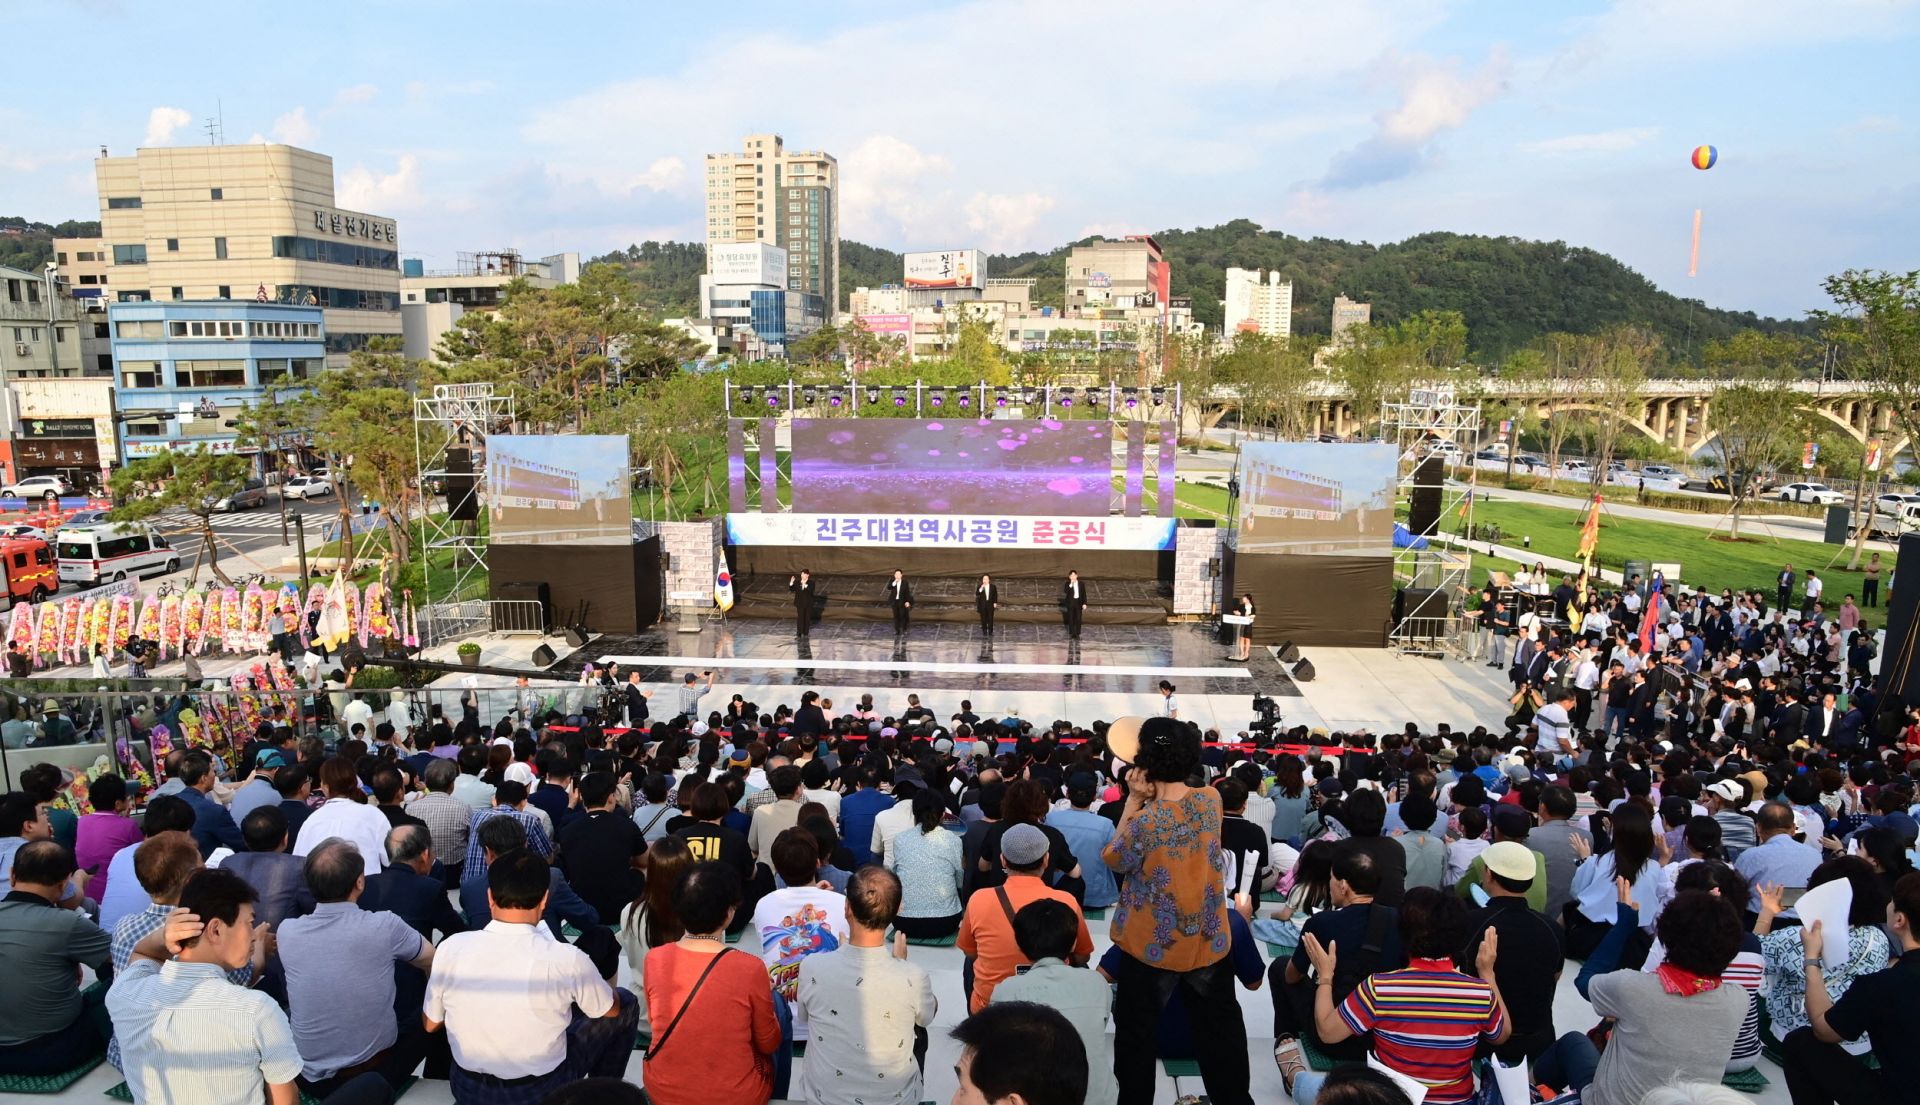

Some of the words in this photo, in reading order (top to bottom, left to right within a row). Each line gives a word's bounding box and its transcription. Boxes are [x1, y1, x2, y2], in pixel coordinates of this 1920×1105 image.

[315, 211, 395, 242] 제일전기조명
[816, 518, 1018, 543] 진주대첩역사공원
[1032, 521, 1106, 545] 준공식
